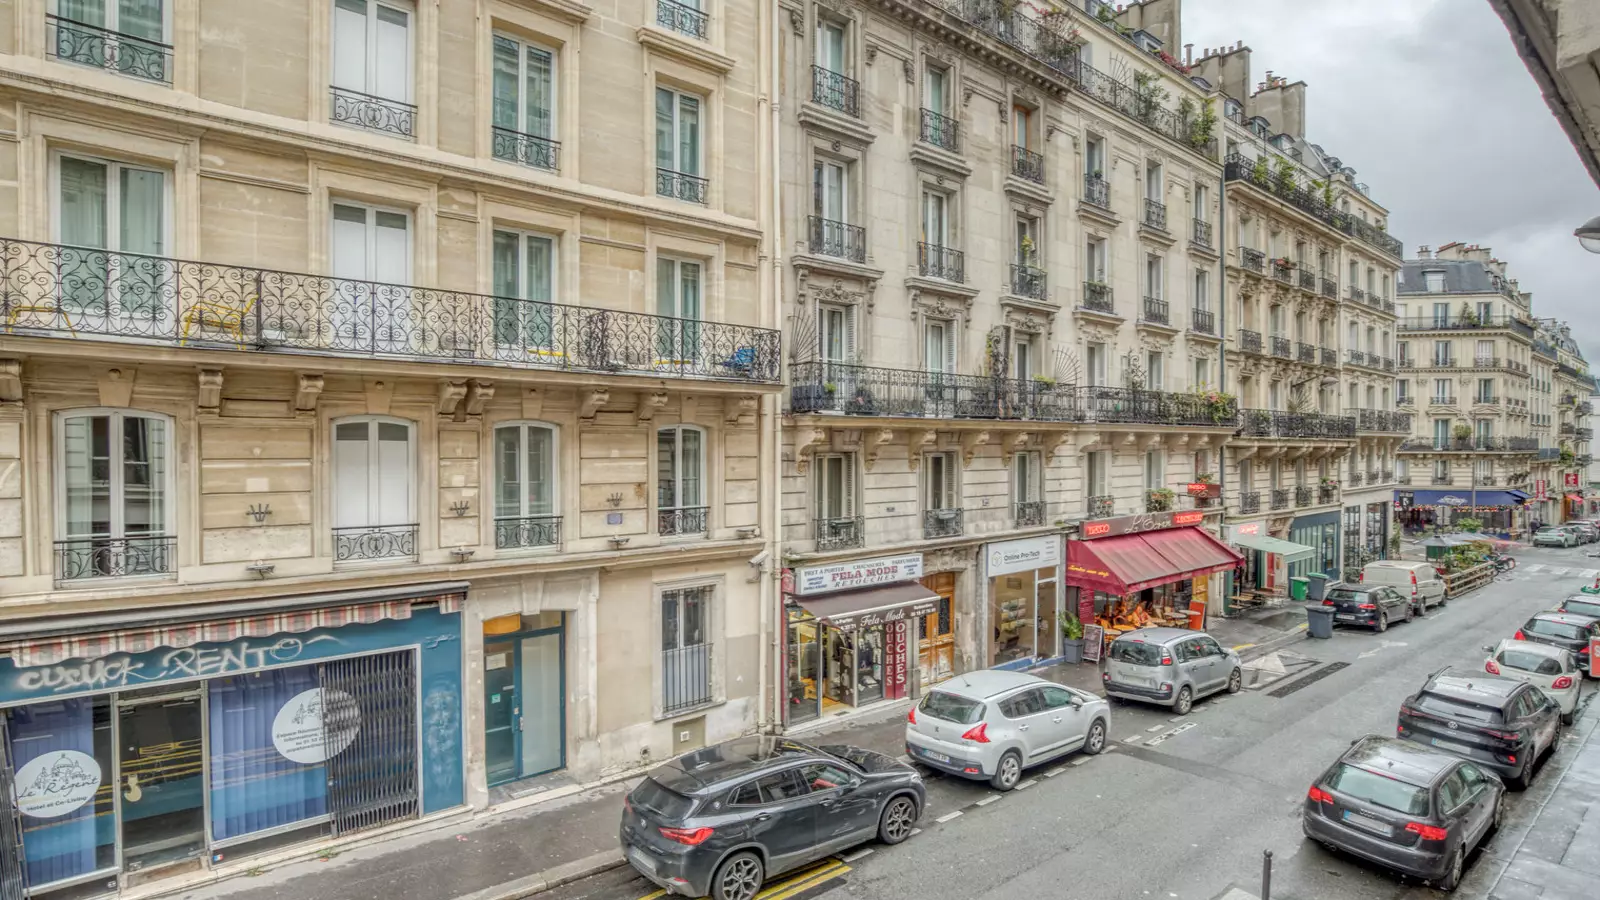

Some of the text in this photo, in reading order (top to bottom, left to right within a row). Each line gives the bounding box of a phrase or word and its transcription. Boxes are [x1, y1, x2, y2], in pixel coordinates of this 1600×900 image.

[831, 570, 863, 582] FELA
[866, 565, 898, 577] MODE
[834, 574, 896, 588] RETOUCHES
[860, 613, 881, 627] Fela
[882, 608, 905, 623] Mode
[18, 786, 36, 798] Le
